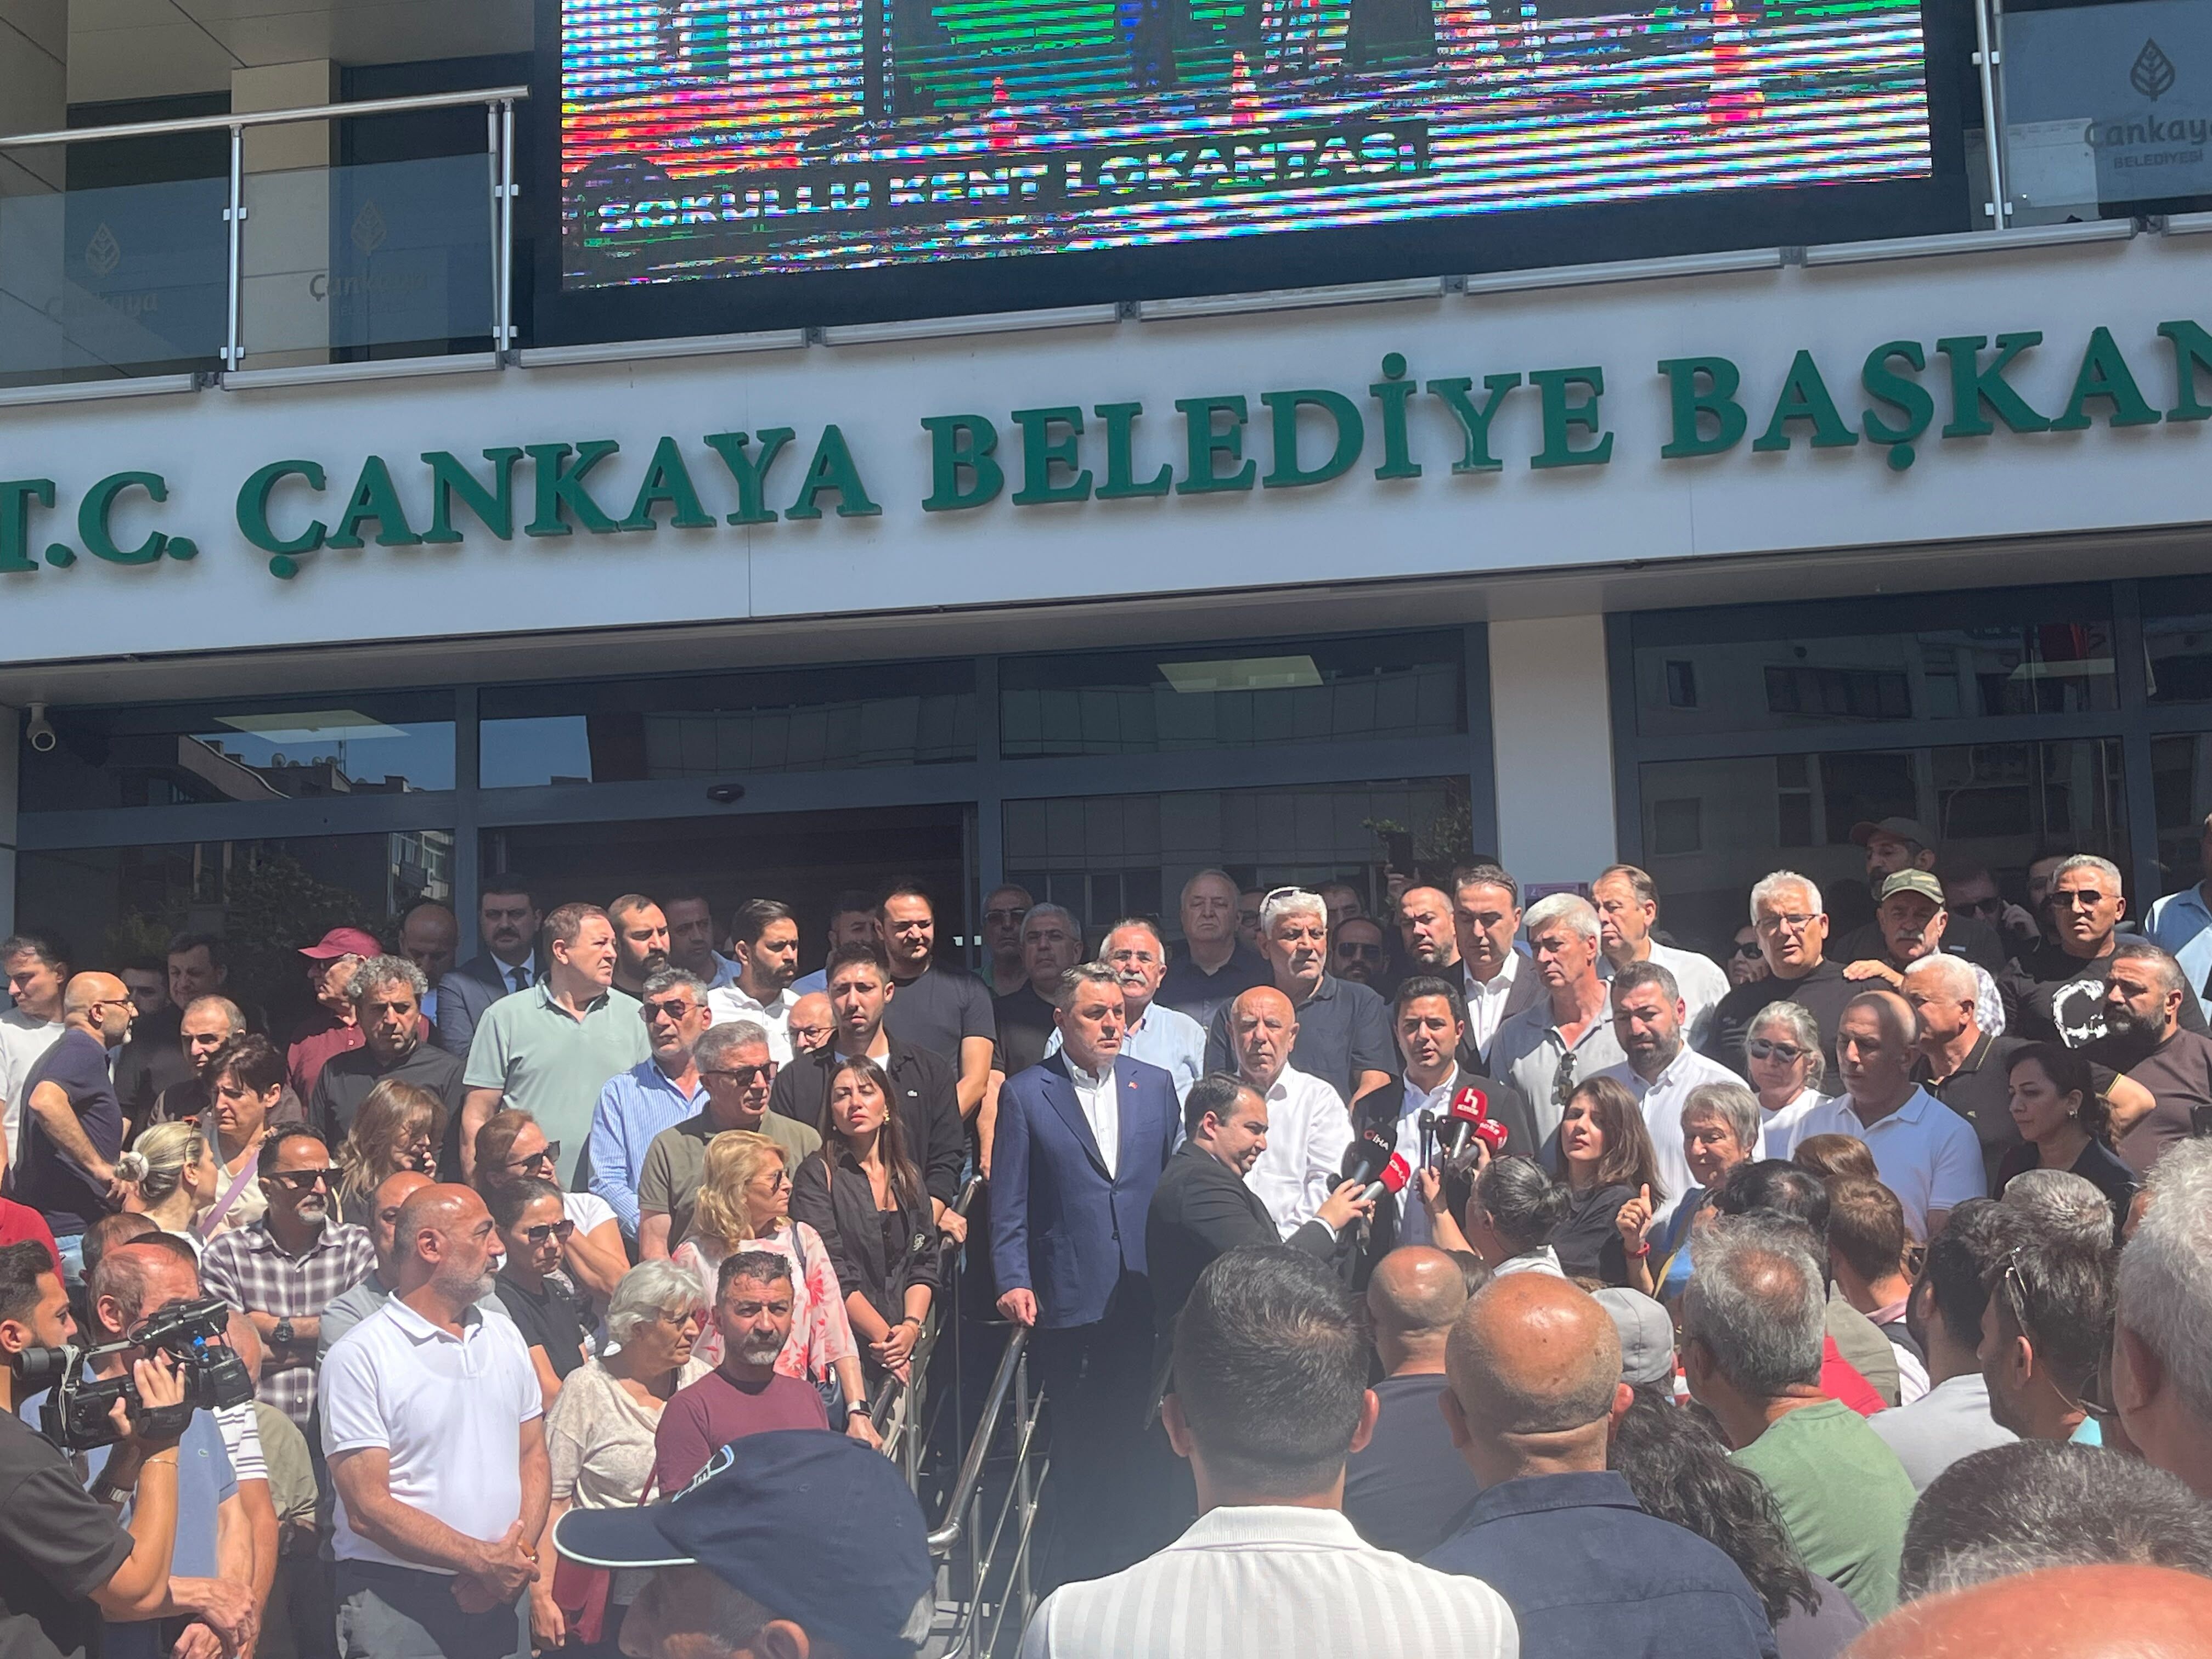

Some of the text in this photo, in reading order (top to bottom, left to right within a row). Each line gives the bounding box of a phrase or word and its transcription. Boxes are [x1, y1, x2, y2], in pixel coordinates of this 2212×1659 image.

[598, 180, 870, 232] SOKULLU
[890, 164, 1048, 207] KENT
[0, 471, 199, 573] T.C.
[236, 424, 882, 580] ÇANKAYA
[921, 352, 1614, 512] BELEDİYE
